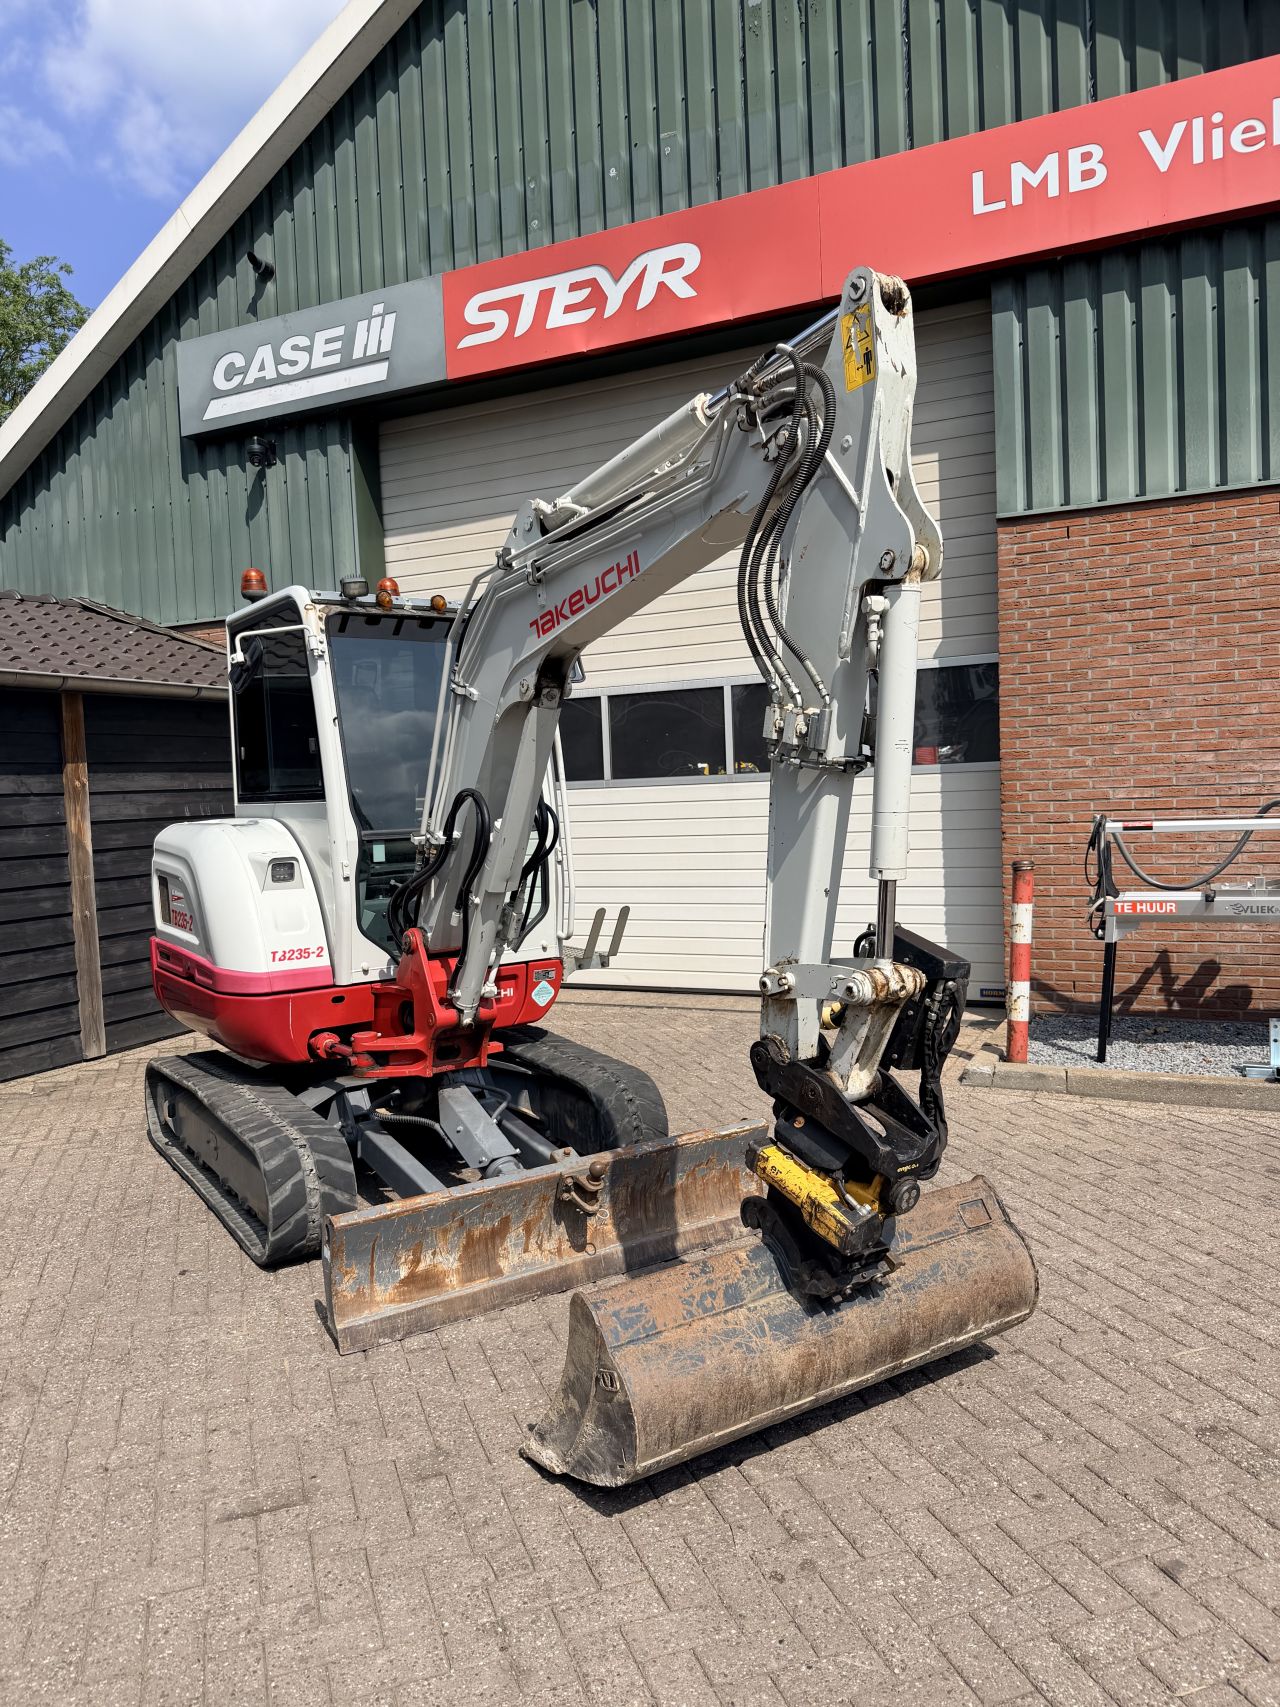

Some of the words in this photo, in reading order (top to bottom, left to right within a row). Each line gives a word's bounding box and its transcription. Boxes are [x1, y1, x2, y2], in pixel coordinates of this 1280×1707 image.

[972, 143, 1108, 215] LMB
[456, 242, 702, 350] STEYR
[212, 324, 346, 391] CASE
[171, 909, 193, 932] TB235-2
[1114, 902, 1133, 913] TE
[1136, 902, 1176, 913] HUUR
[1241, 905, 1275, 914] VLIEK
